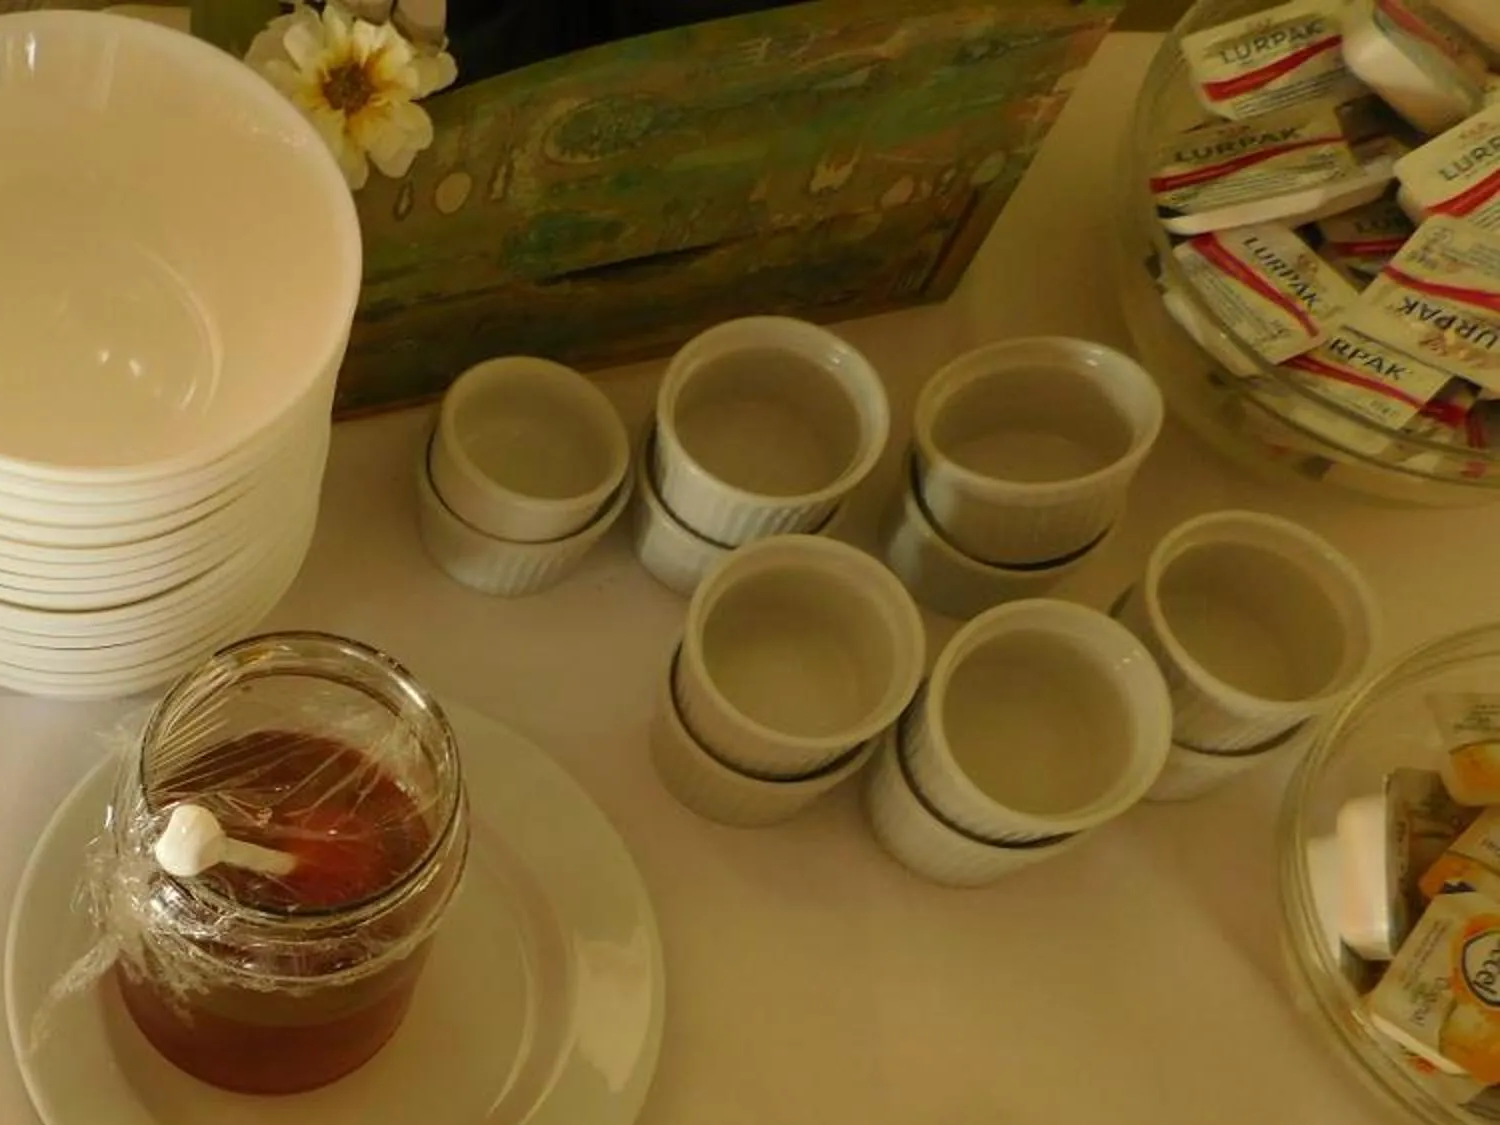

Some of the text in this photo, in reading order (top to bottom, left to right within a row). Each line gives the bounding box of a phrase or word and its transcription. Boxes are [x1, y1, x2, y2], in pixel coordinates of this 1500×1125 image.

[1220, 20, 1324, 65] LURPAK
[1176, 127, 1298, 162] LURPAK
[1243, 236, 1318, 309] LURPAK
